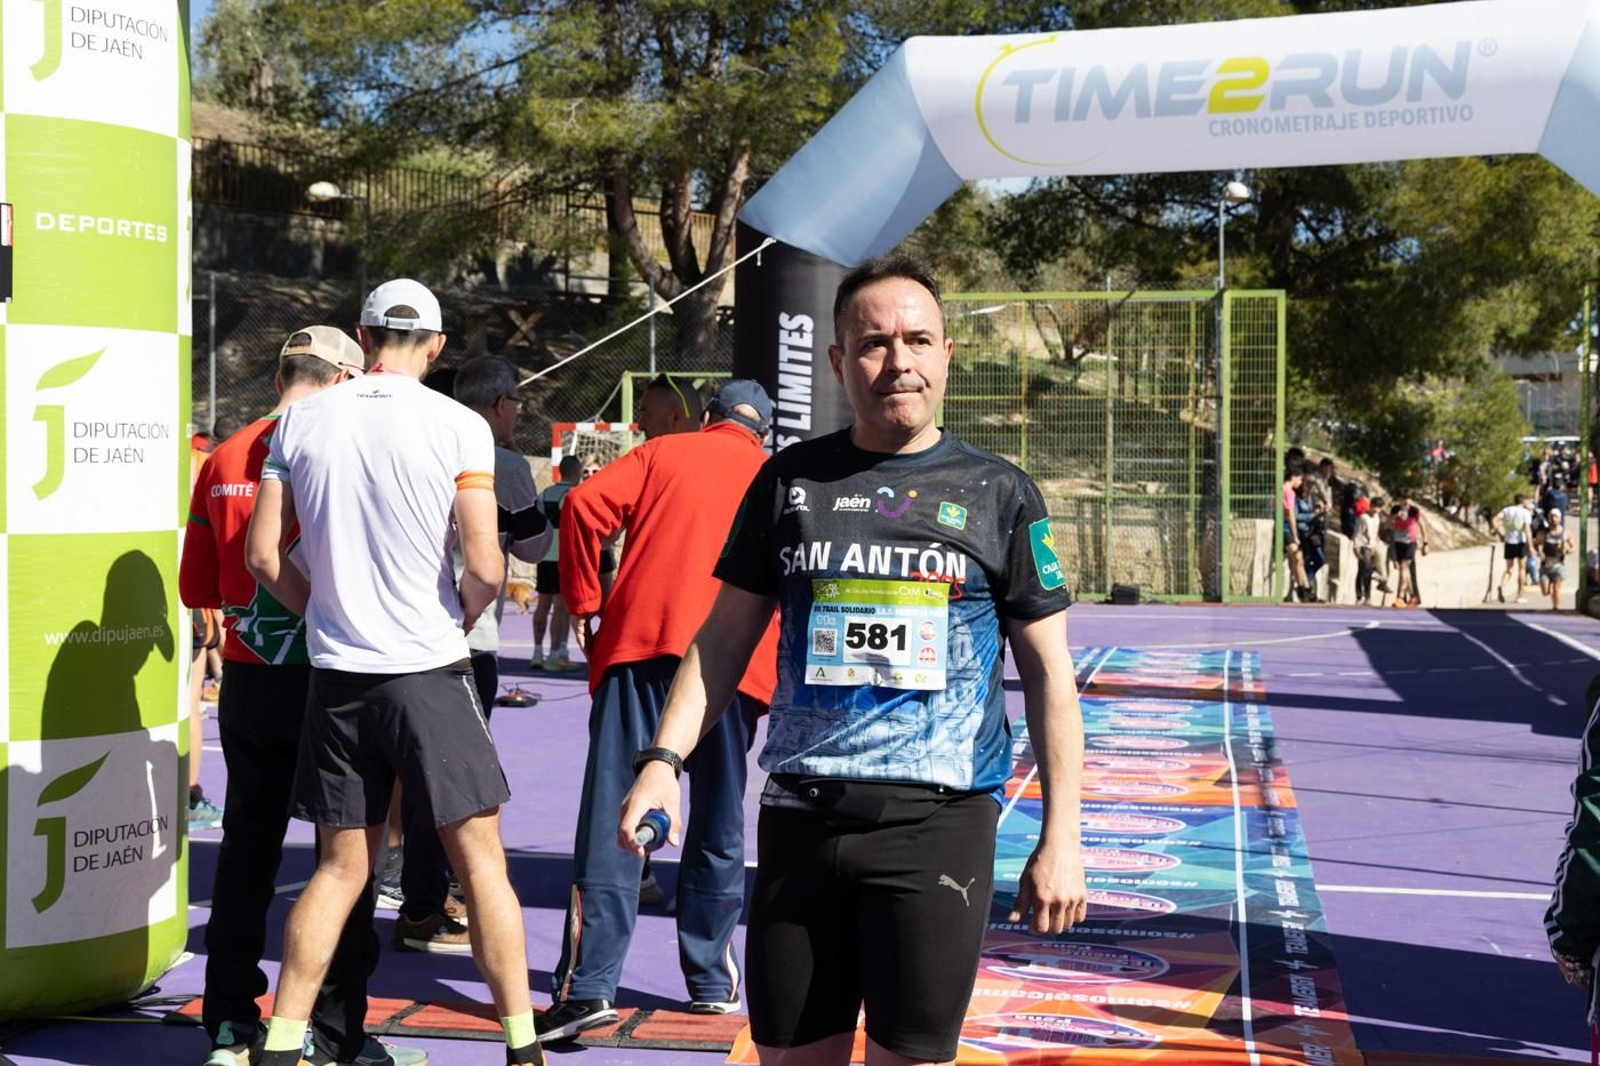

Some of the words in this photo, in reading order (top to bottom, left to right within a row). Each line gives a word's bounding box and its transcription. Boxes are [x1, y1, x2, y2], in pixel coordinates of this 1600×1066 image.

[71, 32, 98, 51] DE
[101, 38, 143, 60] JAÉN
[1002, 41, 1472, 124] TIME2RUN
[1208, 111, 1359, 137] CRONOMETRAJE
[1365, 104, 1473, 129] DEPORTIVO
[36, 212, 168, 243] DEPORTES
[73, 447, 99, 464] DE
[103, 444, 144, 464] JAÉN
[211, 482, 254, 498] COMITÉ
[780, 541, 832, 576] SAN
[840, 543, 967, 584] ANTÓN
[822, 605, 840, 613] TRAIL
[840, 606, 876, 614] SOLIDARIO
[44, 624, 164, 646] www.dipujaen.es
[845, 622, 907, 651] 581
[74, 815, 168, 848] DIPUTACIÓN
[73, 854, 99, 873] DE
[103, 845, 143, 869] JAÉN
[1288, 973, 1321, 1017] TEAMERGY
